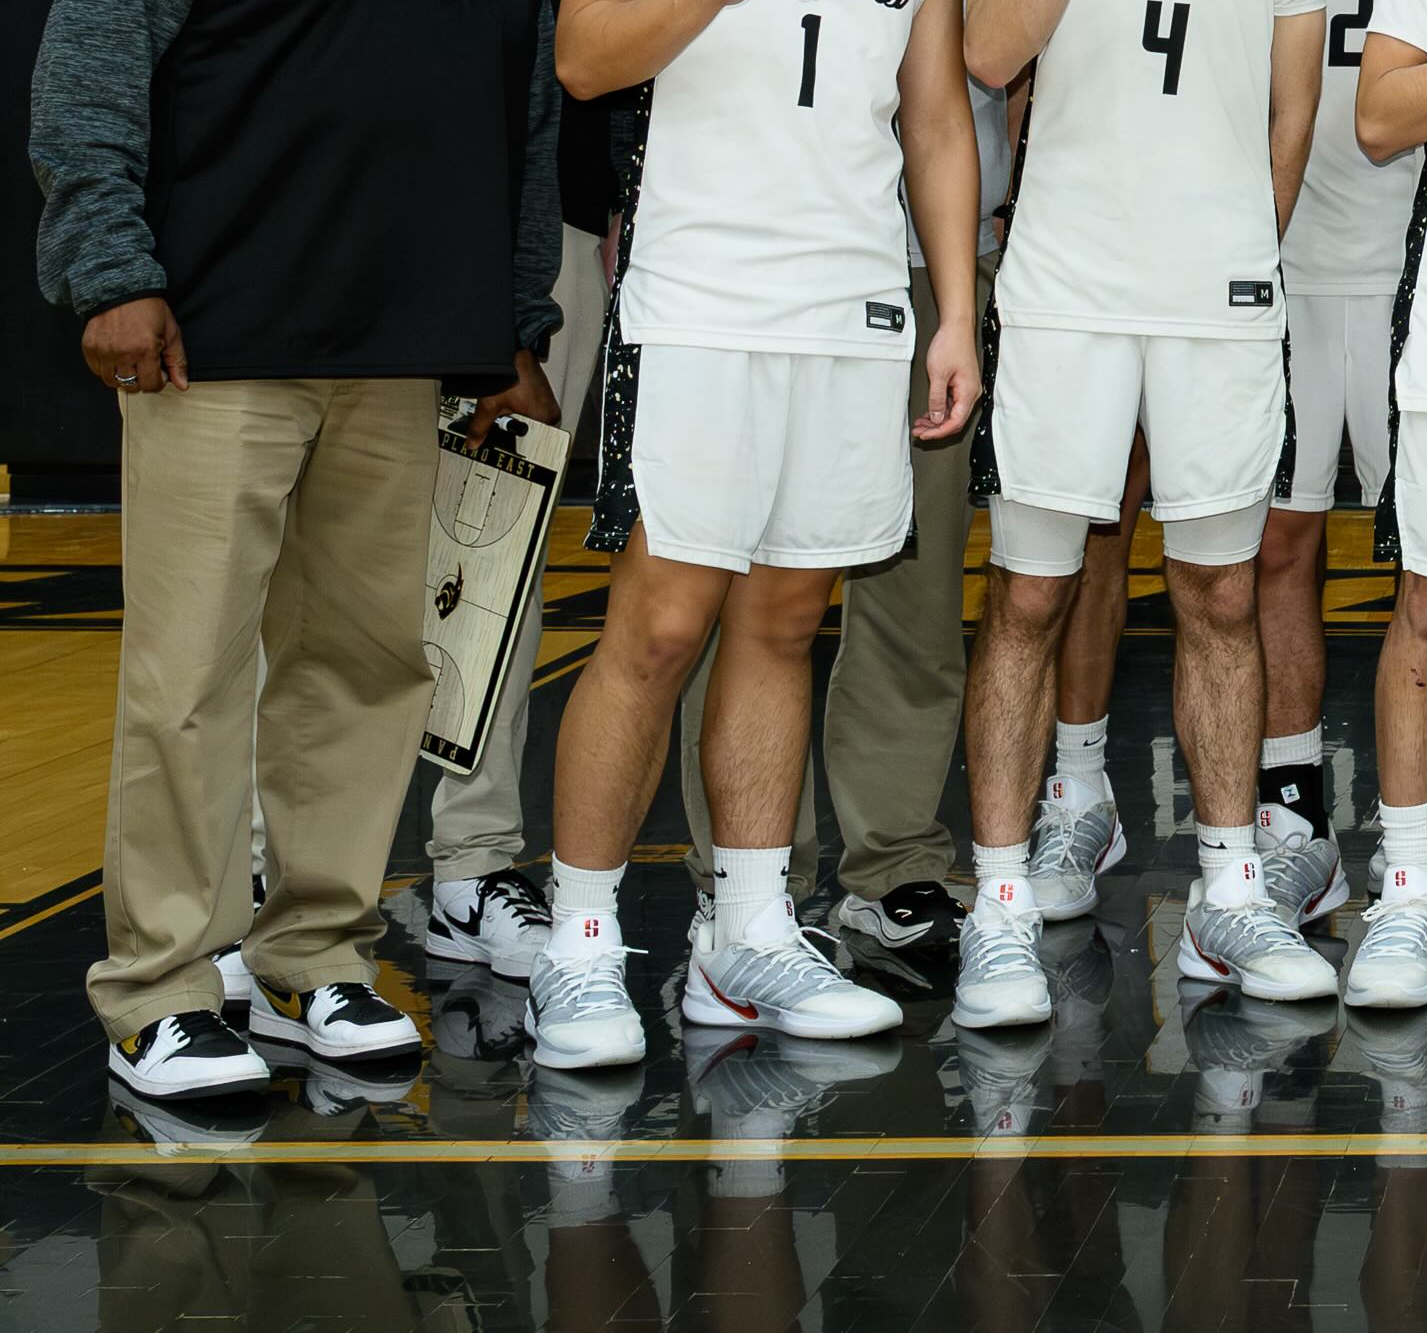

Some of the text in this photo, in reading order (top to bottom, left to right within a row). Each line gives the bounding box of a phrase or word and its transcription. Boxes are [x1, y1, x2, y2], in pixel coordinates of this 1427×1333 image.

[798, 14, 821, 108] 1
[1142, 0, 1190, 95] 4
[496, 453, 536, 479] EAST
